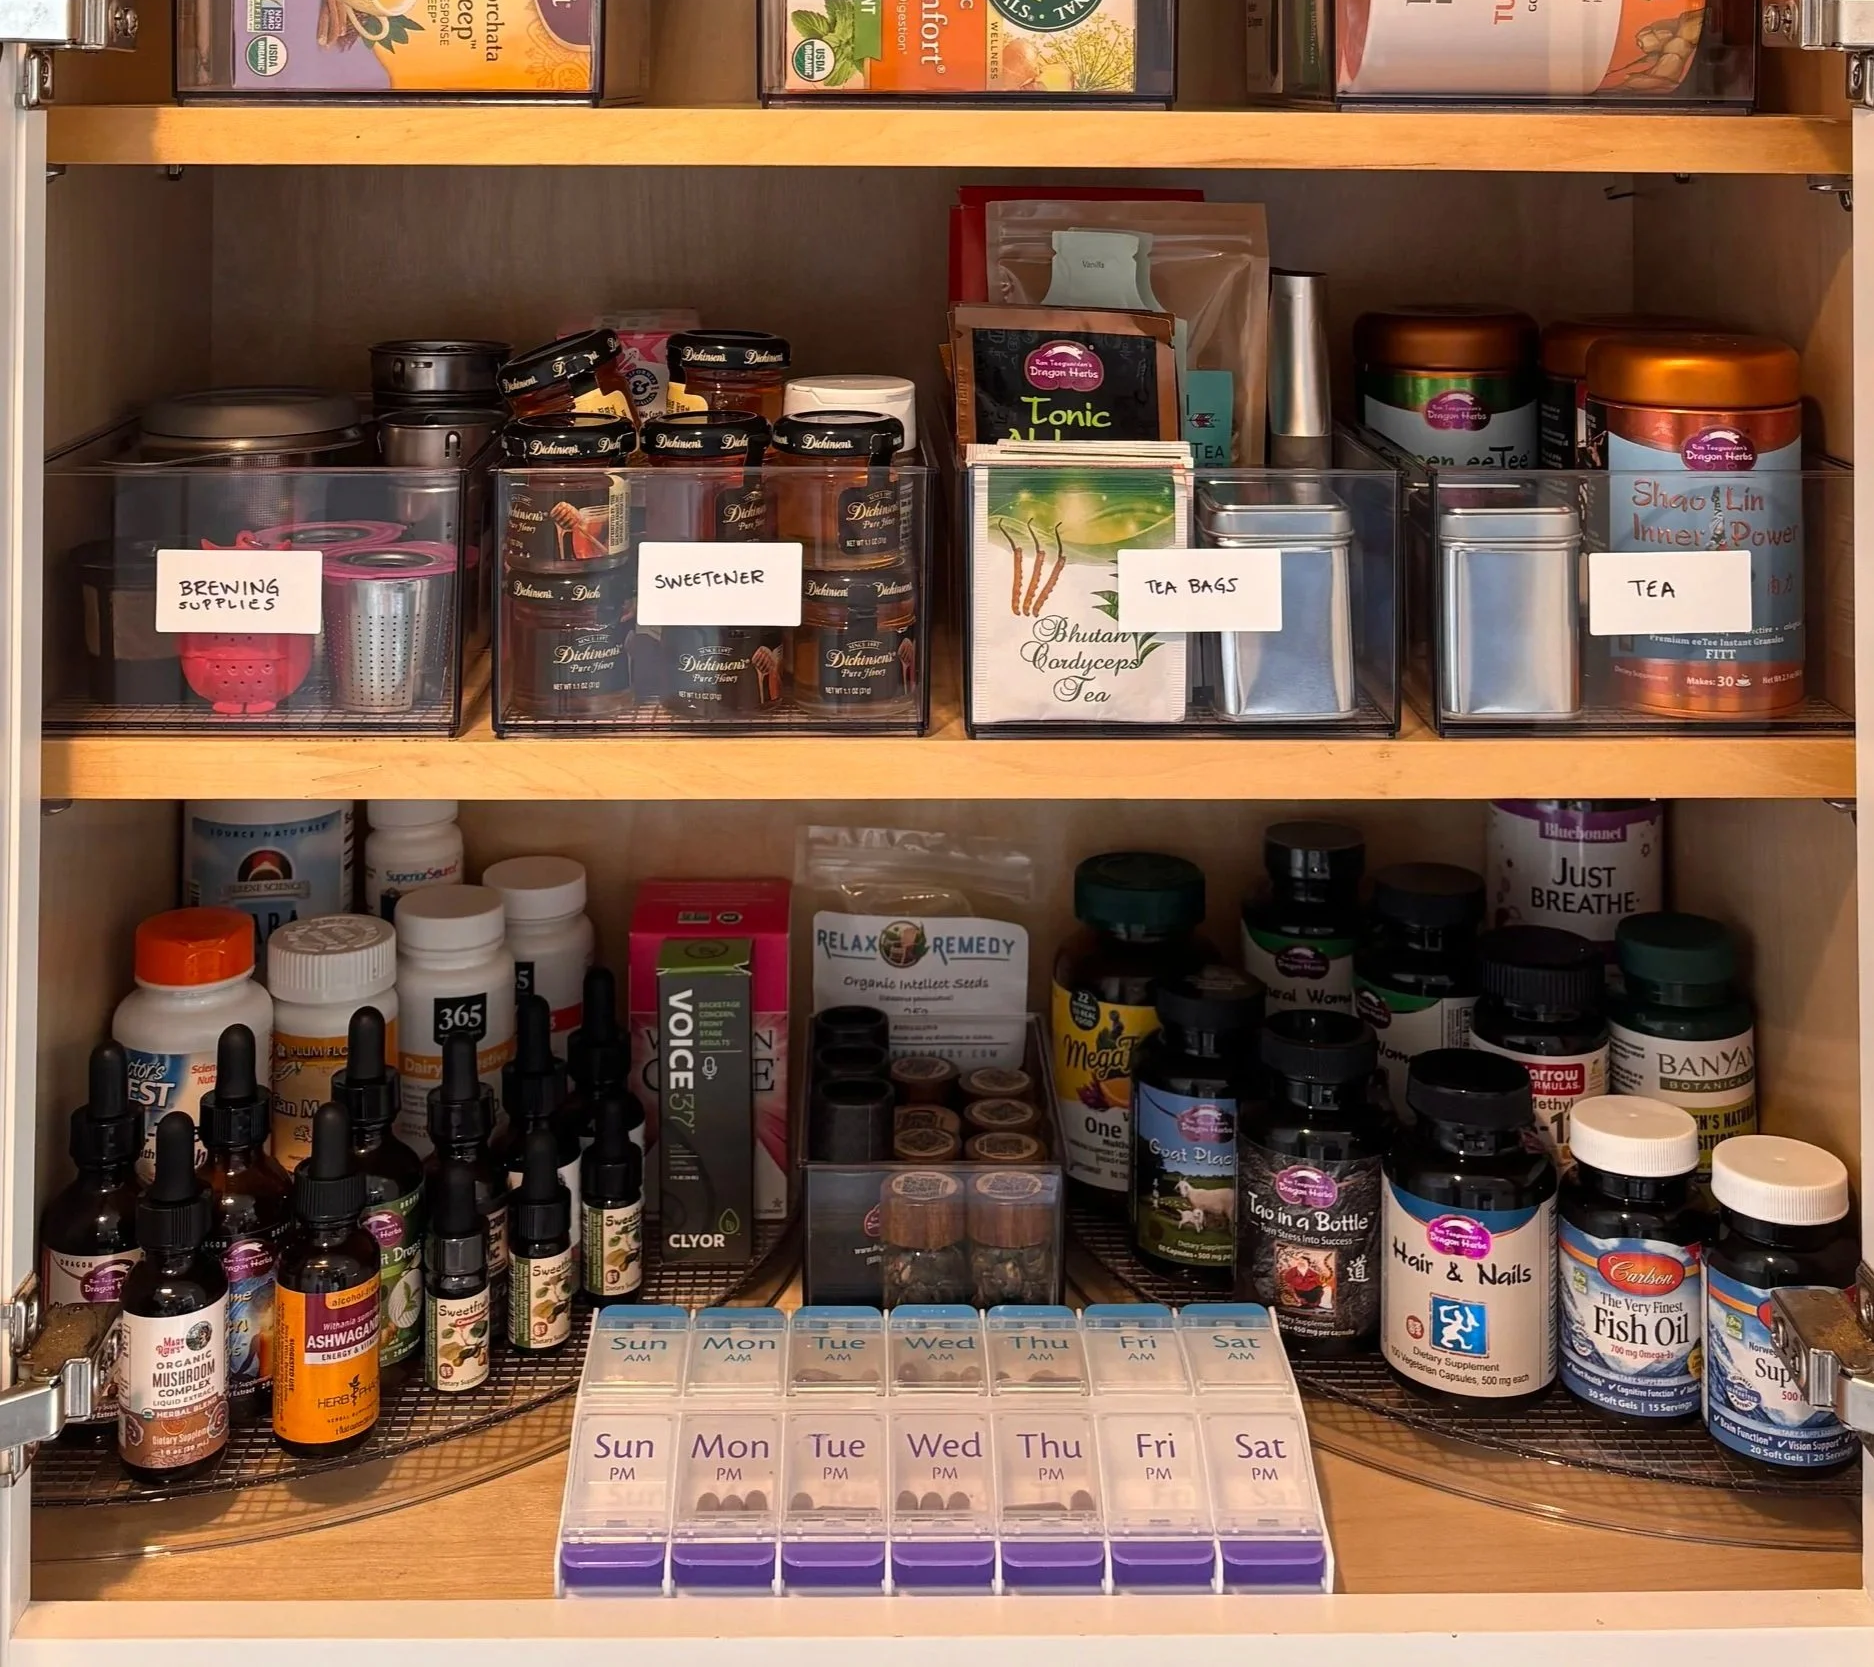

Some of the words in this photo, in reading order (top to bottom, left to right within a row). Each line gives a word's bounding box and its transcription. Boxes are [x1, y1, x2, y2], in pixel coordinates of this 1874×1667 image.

[1022, 396, 1112, 429] Tonic
[1631, 480, 1706, 511] Shao
[1724, 487, 1764, 511] Lin
[1632, 515, 1705, 546] Inner
[1729, 521, 1799, 547] Power
[179, 579, 279, 597] BREWING
[655, 570, 765, 590] SWEETENER
[1144, 580, 1177, 594] TEA
[1188, 578, 1239, 594] BAGS
[1628, 579, 1675, 599] TEA
[179, 598, 275, 611] SUPPLIES
[1032, 614, 1130, 644] Bhutan
[1020, 640, 1141, 674] Cordyceps
[1705, 649, 1736, 659] FITT
[1053, 676, 1110, 704] Tea
[1531, 887, 1635, 915] BREATHE
[817, 929, 877, 953] RELAX
[933, 936, 1015, 957] REMEDY
[439, 1005, 482, 1030] 365
[668, 989, 694, 1089] VOICE
[1248, 1191, 1273, 1220] Tao
[1278, 1207, 1292, 1226] in
[1296, 1218, 1309, 1230] a
[669, 1233, 725, 1248] CLYOR
[1393, 1236, 1433, 1274] Hair
[1446, 1261, 1463, 1282] &
[1477, 1263, 1531, 1285] Nails
[1600, 1292, 1621, 1308] The
[1624, 1298, 1650, 1316] Very
[1653, 1301, 1683, 1313] Finest
[1593, 1305, 1648, 1345] Fish
[1655, 1314, 1689, 1346] Oil
[610, 1336, 668, 1352] Sun
[702, 1336, 775, 1352] Mon
[812, 1336, 866, 1352] Tue
[905, 1335, 977, 1352] Wed
[1010, 1335, 1069, 1352] Thu
[1120, 1335, 1156, 1352] Fri
[1212, 1335, 1261, 1352] Sat
[156, 1350, 212, 1370] ORGANIC
[623, 1353, 651, 1362] AM
[724, 1353, 752, 1362] AM
[825, 1352, 853, 1362] AM
[927, 1352, 955, 1362] AM
[1027, 1352, 1054, 1362] AM
[1128, 1352, 1155, 1362] AM
[1228, 1352, 1255, 1361] AM
[152, 1361, 215, 1387] MUSHROOM
[158, 1379, 211, 1398] COMPLEX
[595, 1434, 655, 1460] Sun
[691, 1434, 770, 1460] Mon
[811, 1434, 866, 1460] Tue
[907, 1433, 982, 1459] Wed
[1017, 1433, 1082, 1459] Thu
[1137, 1433, 1176, 1459] Fri
[1236, 1433, 1287, 1459] Sat
[610, 1467, 636, 1481] PM
[716, 1467, 743, 1481] PM
[823, 1467, 849, 1481] PM
[932, 1466, 958, 1480] PM
[1039, 1466, 1065, 1480] PM
[1146, 1466, 1172, 1480] PM
[1252, 1466, 1278, 1480] PM
